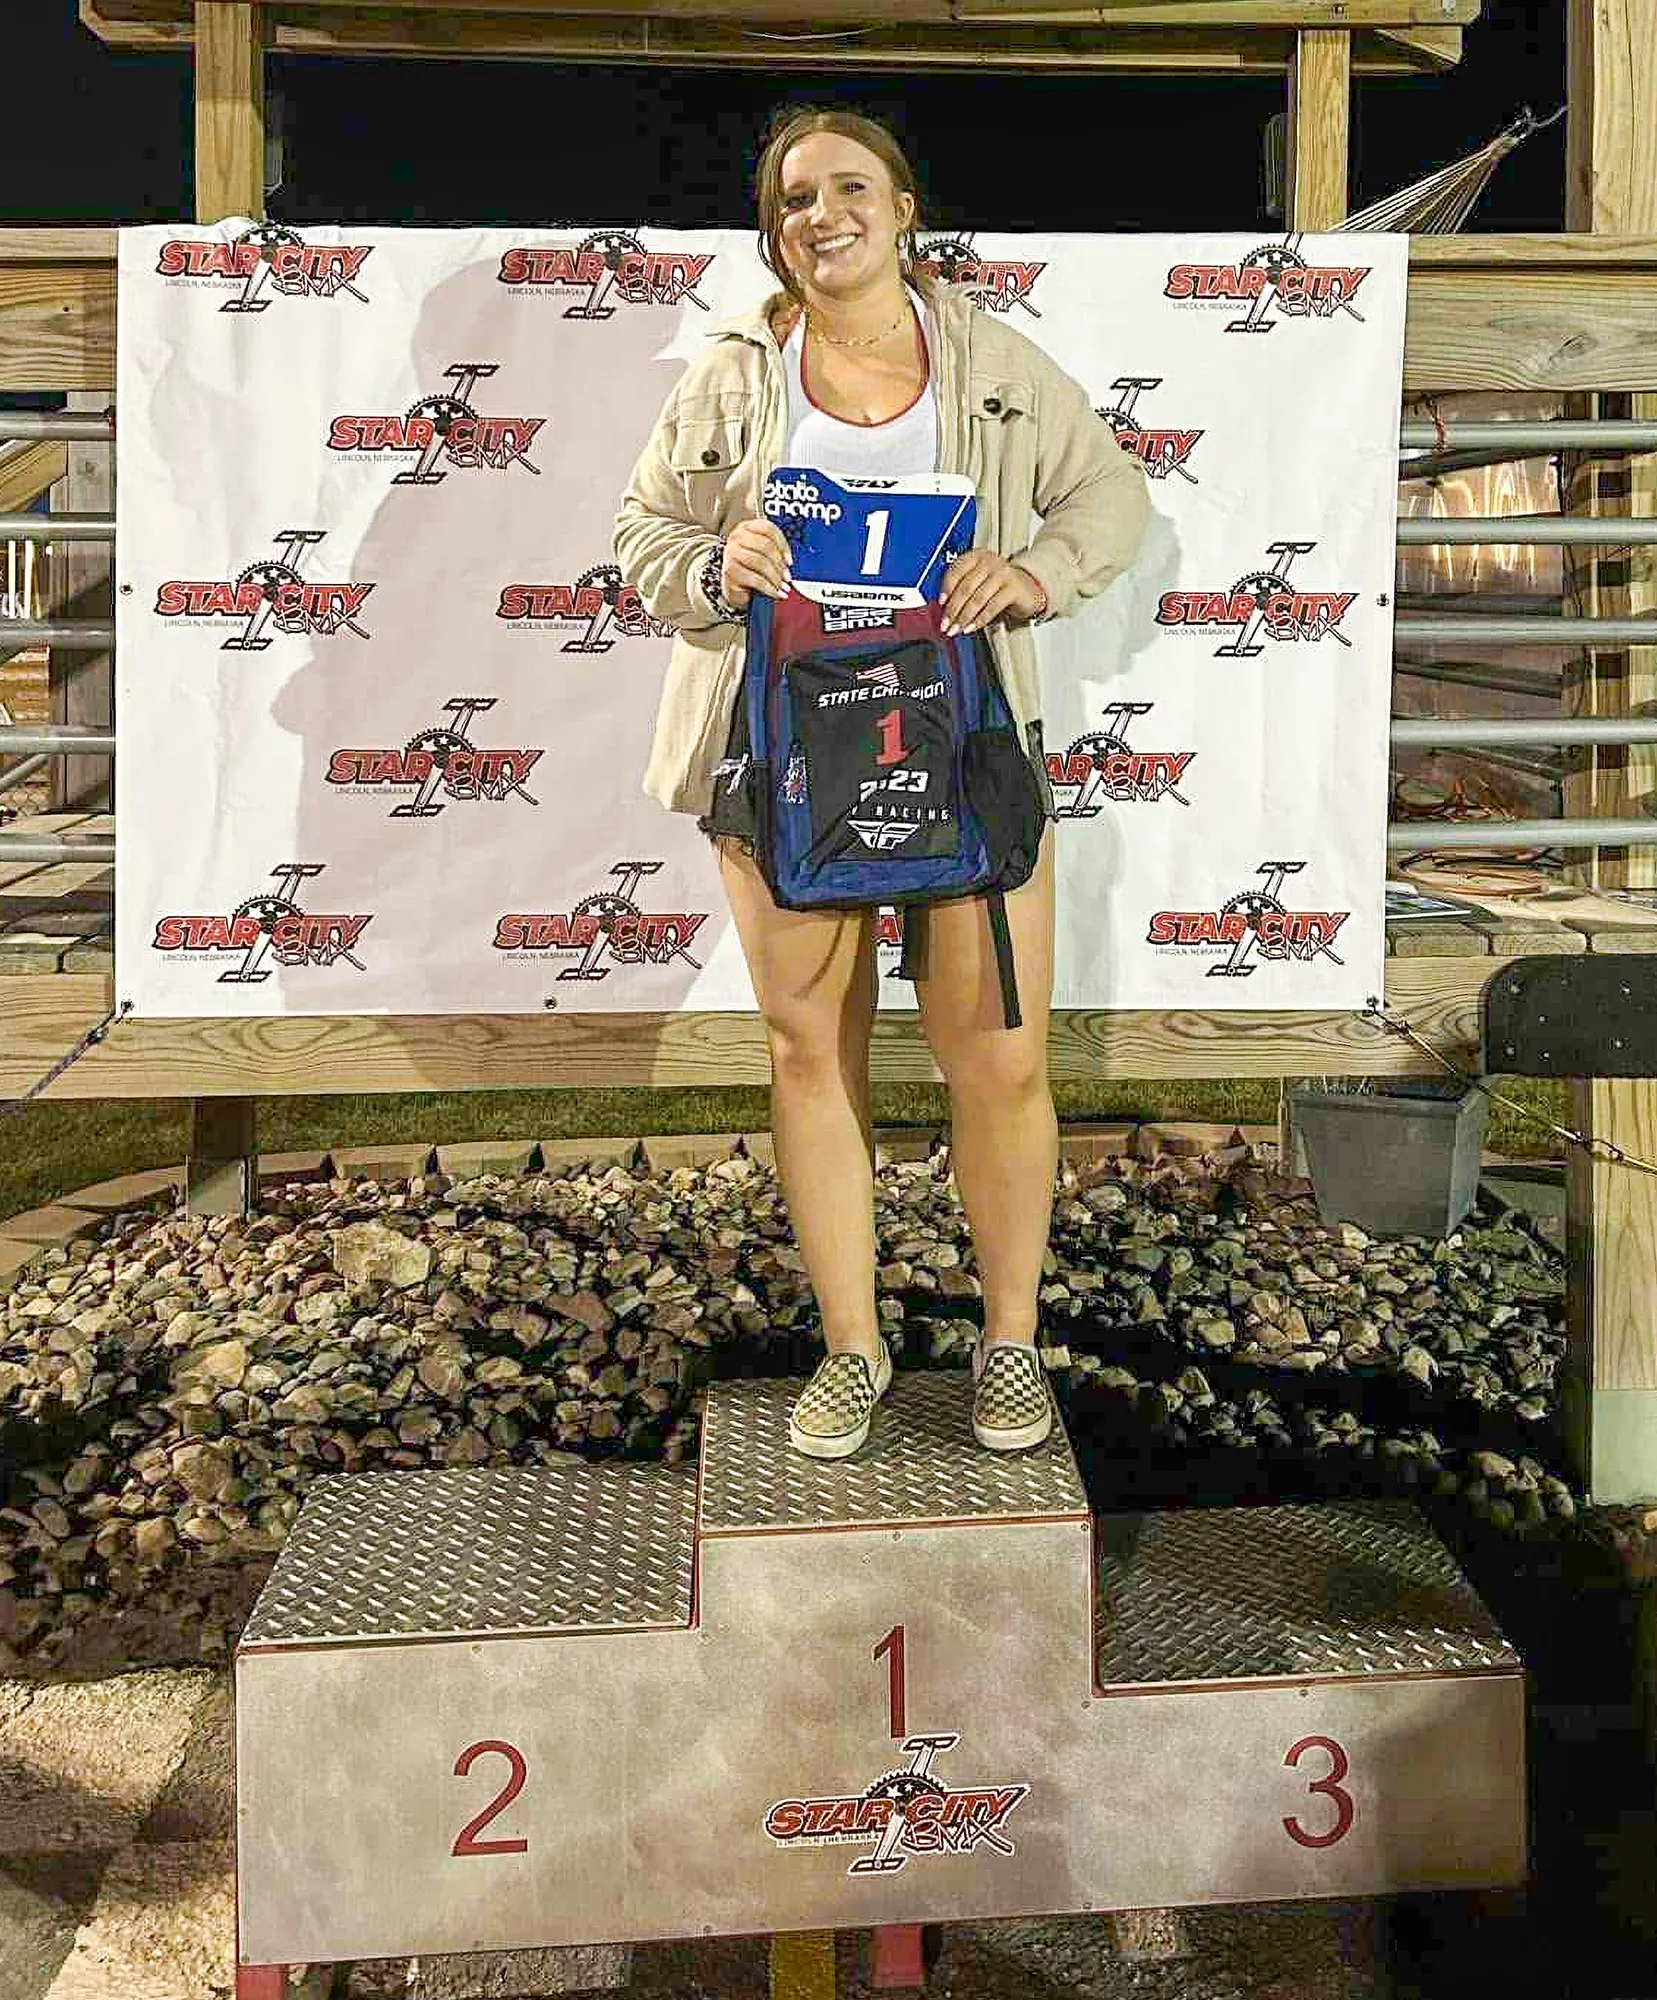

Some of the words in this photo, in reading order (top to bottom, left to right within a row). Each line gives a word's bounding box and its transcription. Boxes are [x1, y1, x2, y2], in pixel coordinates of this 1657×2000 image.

[156, 240, 261, 278] STAR
[273, 246, 376, 280] CITY
[496, 249, 602, 285] STAR
[616, 253, 717, 288] CITY
[272, 270, 370, 303] BMX
[615, 277, 711, 310] BMX
[1164, 265, 1267, 299] STAR
[1280, 267, 1373, 300] CITY
[1276, 289, 1365, 322] BMX
[326, 416, 435, 451] STAR
[449, 418, 547, 452] CITY
[447, 441, 542, 474] BMX
[860, 511, 890, 576] 1
[154, 581, 263, 616] STAR
[272, 583, 377, 617] CITY
[496, 585, 603, 619] STAR
[1155, 591, 1256, 625] STAR
[1266, 592, 1359, 625] CITY
[274, 608, 370, 639] BMX
[1265, 616, 1352, 646] BMX
[818, 687, 870, 708] STATE
[876, 710, 906, 767] 1
[325, 749, 434, 784] STAR
[448, 750, 545, 784] CITY
[1046, 752, 1093, 786] AR
[1103, 752, 1197, 785] CITY
[444, 774, 540, 805] BMX
[1102, 776, 1190, 806] BMX
[876, 805, 951, 820] RACING
[152, 916, 262, 951] STAR
[272, 915, 374, 950] CITY
[493, 914, 601, 949] STAR
[613, 914, 709, 949] CITY
[1147, 911, 1246, 944] STAR
[1260, 912, 1350, 945] CITY
[271, 941, 367, 971] BMX
[610, 938, 703, 969] BMX
[1258, 935, 1344, 965] BMX
[873, 1624, 906, 1739] 1
[452, 1740, 528, 1857] 2
[1282, 1736, 1353, 1848] 3
[765, 1798, 894, 1837] STAR
[905, 1785, 1029, 1823] CITY
[901, 1818, 1014, 1855] BMX
